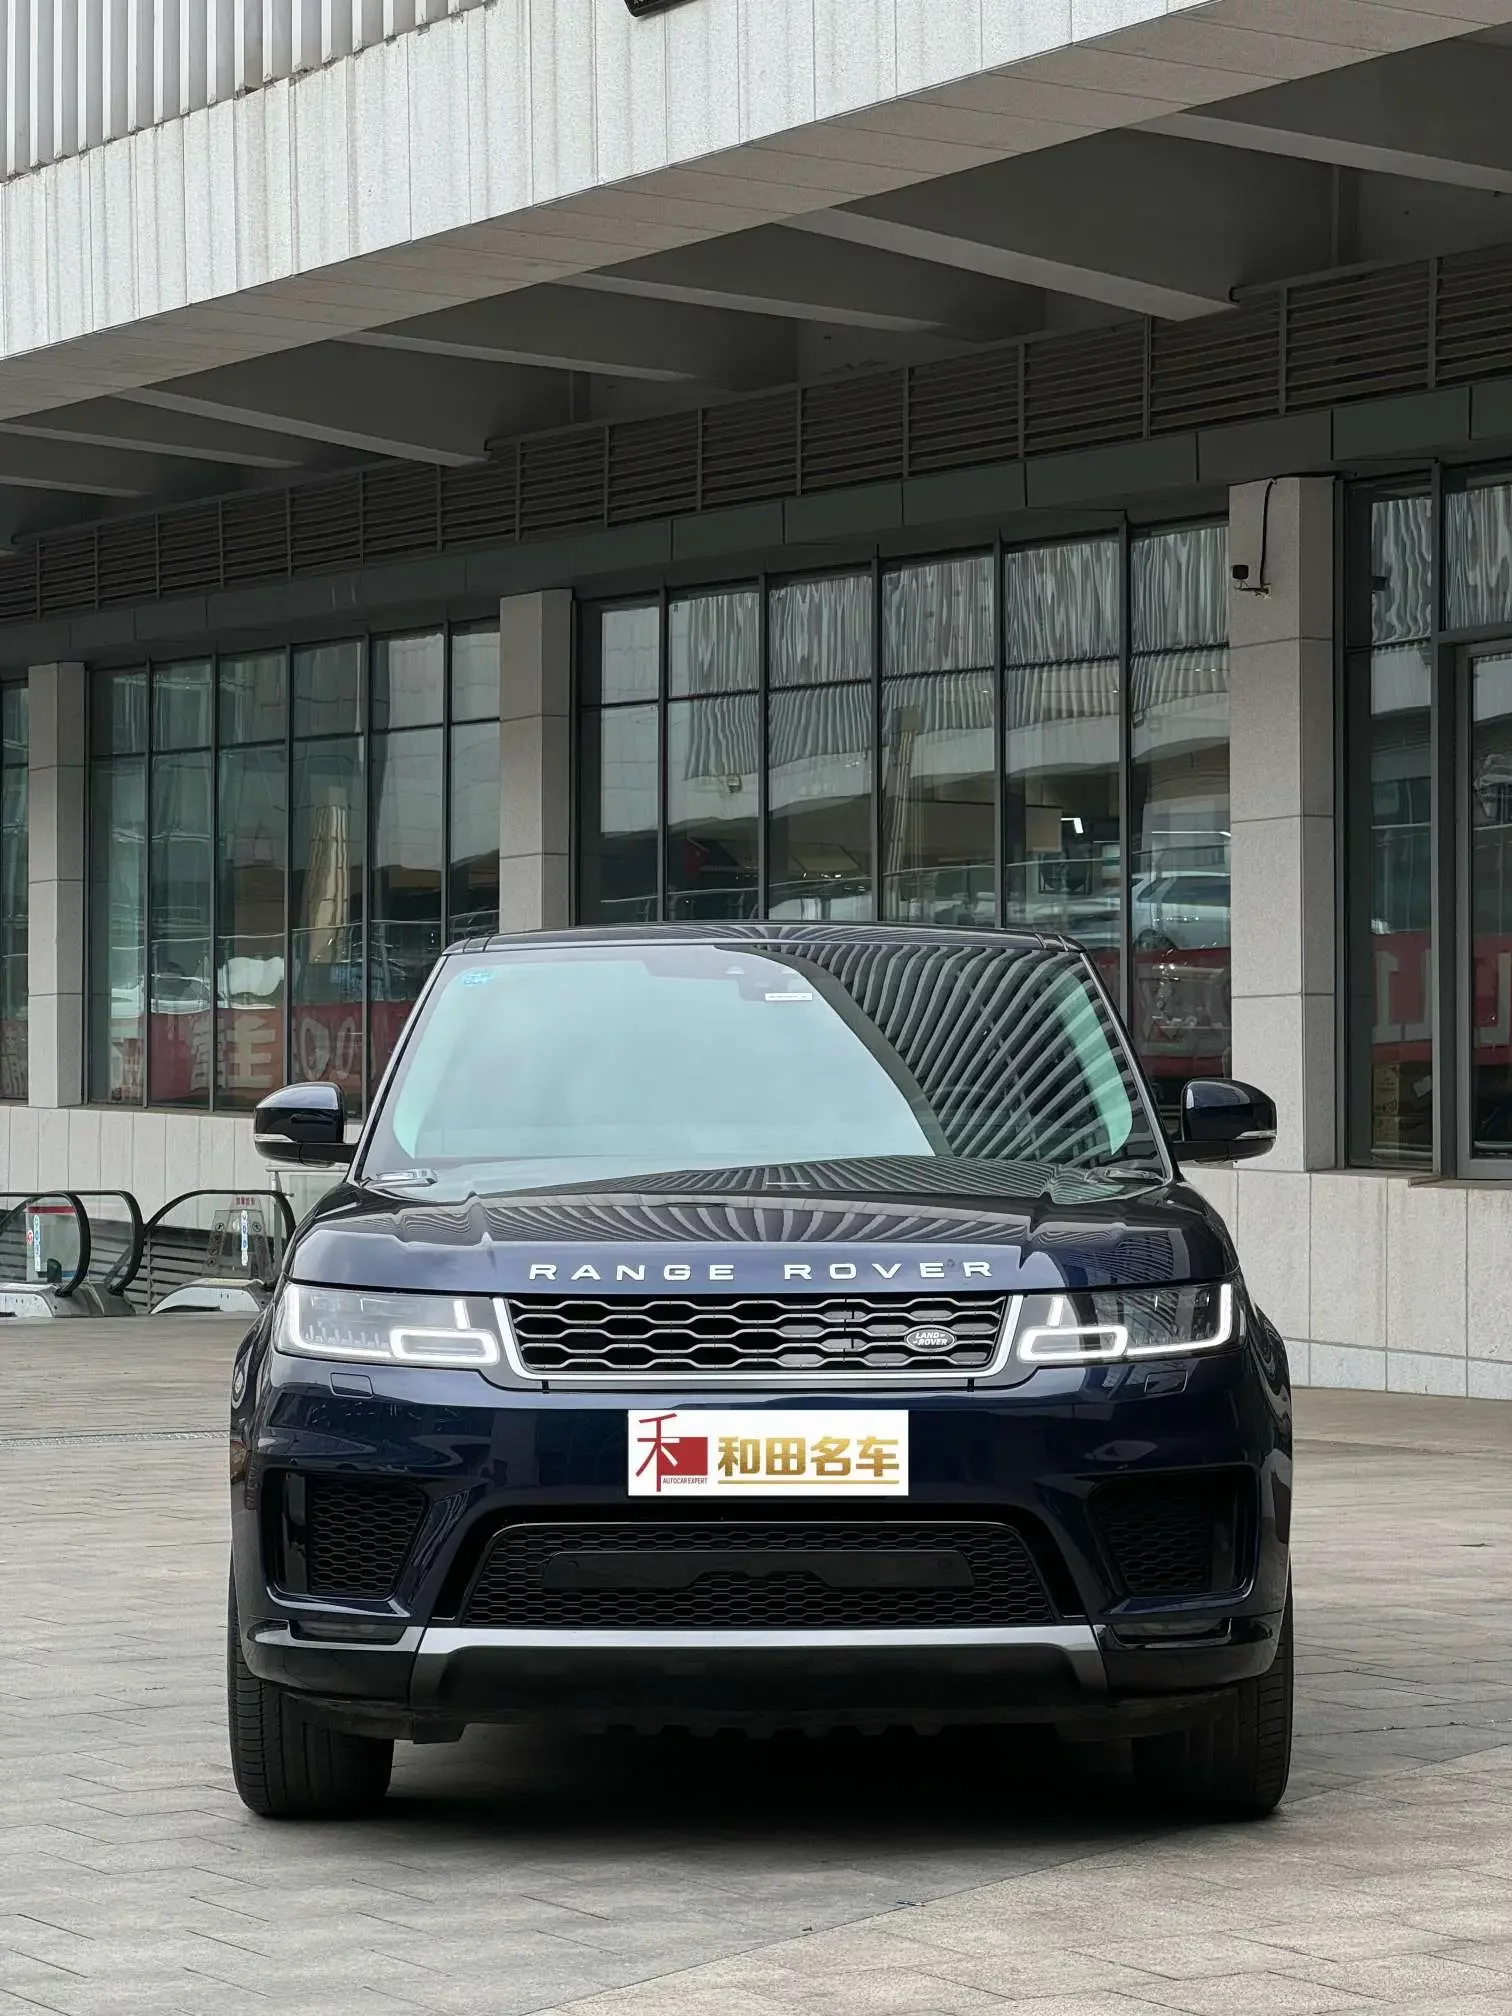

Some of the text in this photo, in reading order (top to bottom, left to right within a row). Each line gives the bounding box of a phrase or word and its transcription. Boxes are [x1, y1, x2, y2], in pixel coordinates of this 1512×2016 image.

[528, 1261, 993, 1281] RANGE ROVER
[718, 1436, 900, 1477] 和田名车
